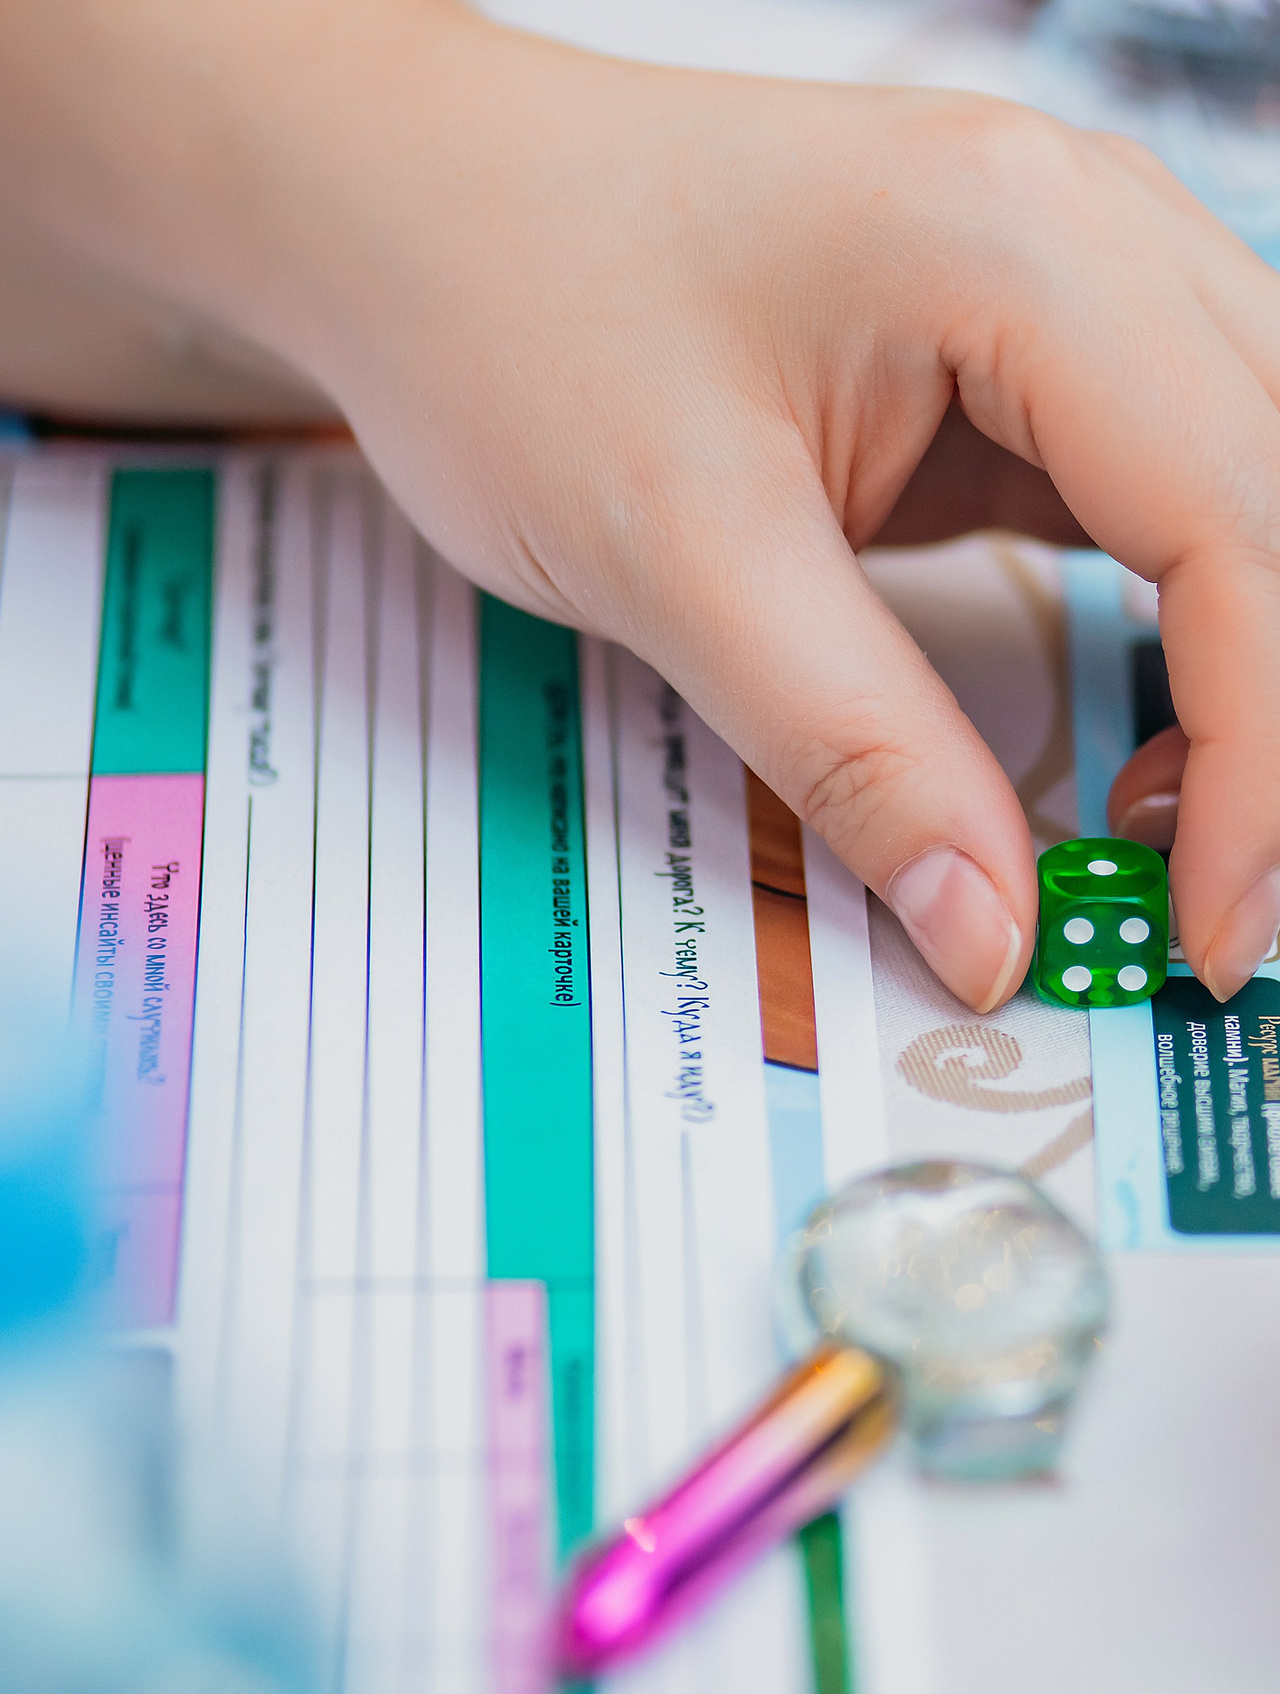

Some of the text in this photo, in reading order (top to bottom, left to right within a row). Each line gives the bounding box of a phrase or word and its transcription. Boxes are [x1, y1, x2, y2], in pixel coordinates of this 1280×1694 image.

[552, 878, 579, 928] вашей
[654, 852, 705, 916] дорога?
[96, 903, 124, 967] инсайты
[144, 893, 169, 933] здесь
[674, 921, 705, 933] К
[147, 937, 167, 950] со
[144, 955, 170, 992] мной
[549, 931, 582, 1007] карточке)
[661, 996, 711, 1044] Куда
[1223, 1015, 1249, 1067] камни).
[681, 1051, 701, 1060] я
[1157, 1034, 1183, 1108] волшебное
[1186, 1022, 1210, 1077] доверие
[1195, 1080, 1215, 1135] высшим
[1227, 1069, 1249, 1115] Магия,
